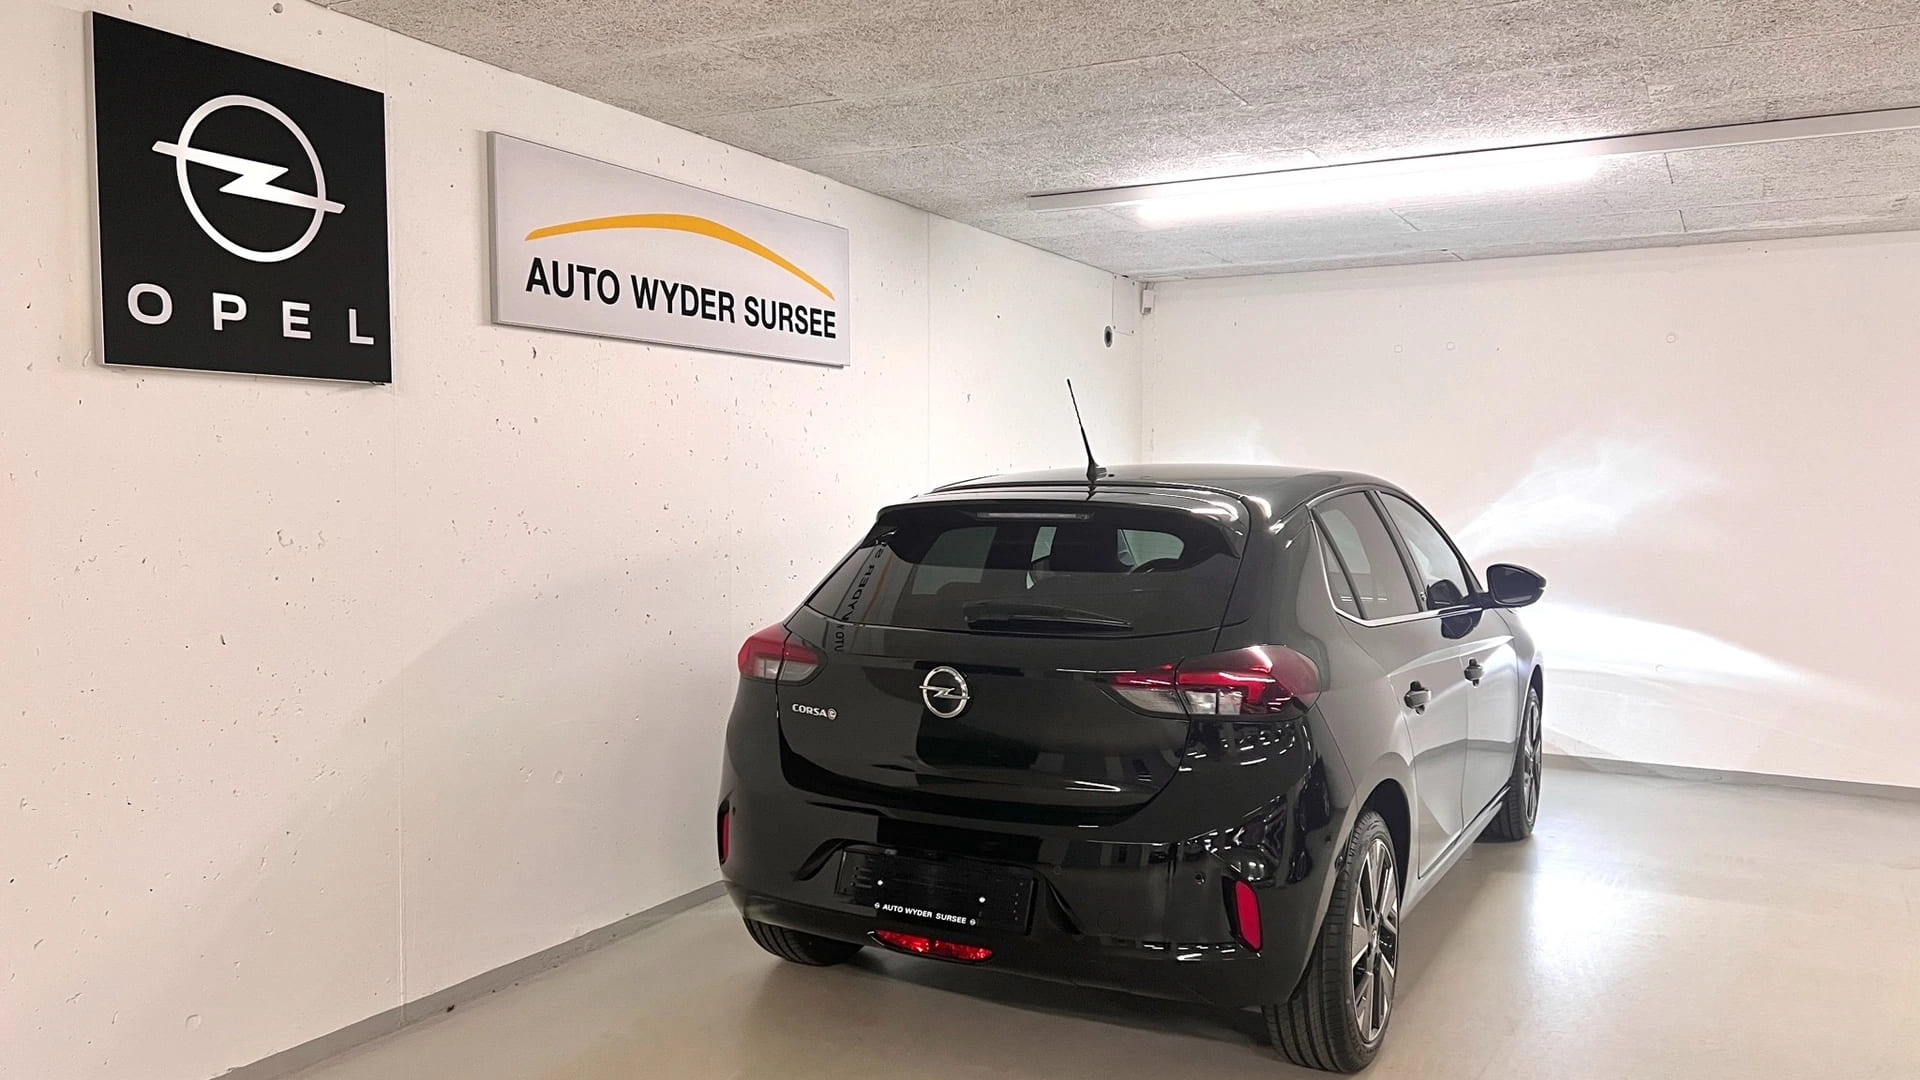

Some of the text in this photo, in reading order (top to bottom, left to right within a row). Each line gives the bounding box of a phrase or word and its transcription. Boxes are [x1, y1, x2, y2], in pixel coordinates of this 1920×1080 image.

[127, 283, 374, 345] OPEL
[525, 257, 836, 339] AUTO WYDER SURSEE
[882, 903, 967, 924] AUTO WYDER SURSEE
